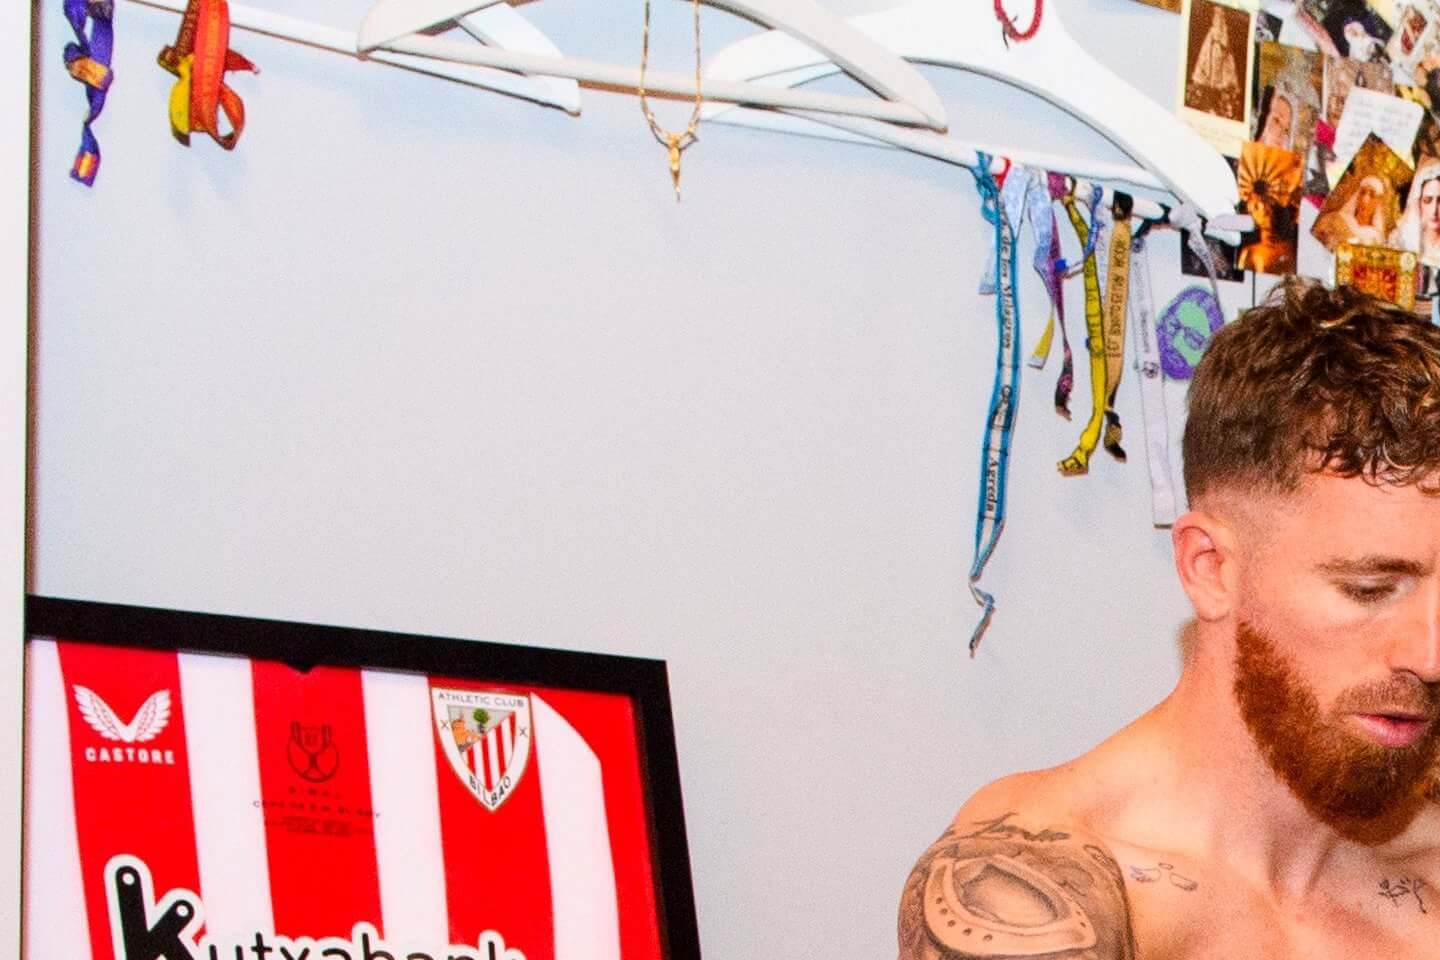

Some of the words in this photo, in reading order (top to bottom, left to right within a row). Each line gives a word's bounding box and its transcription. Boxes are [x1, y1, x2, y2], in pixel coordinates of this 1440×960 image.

[438, 691, 490, 706] ATHLETIC
[494, 696, 525, 708] CLUB
[84, 746, 176, 766] CASTORE
[469, 775, 512, 807] BILBAO
